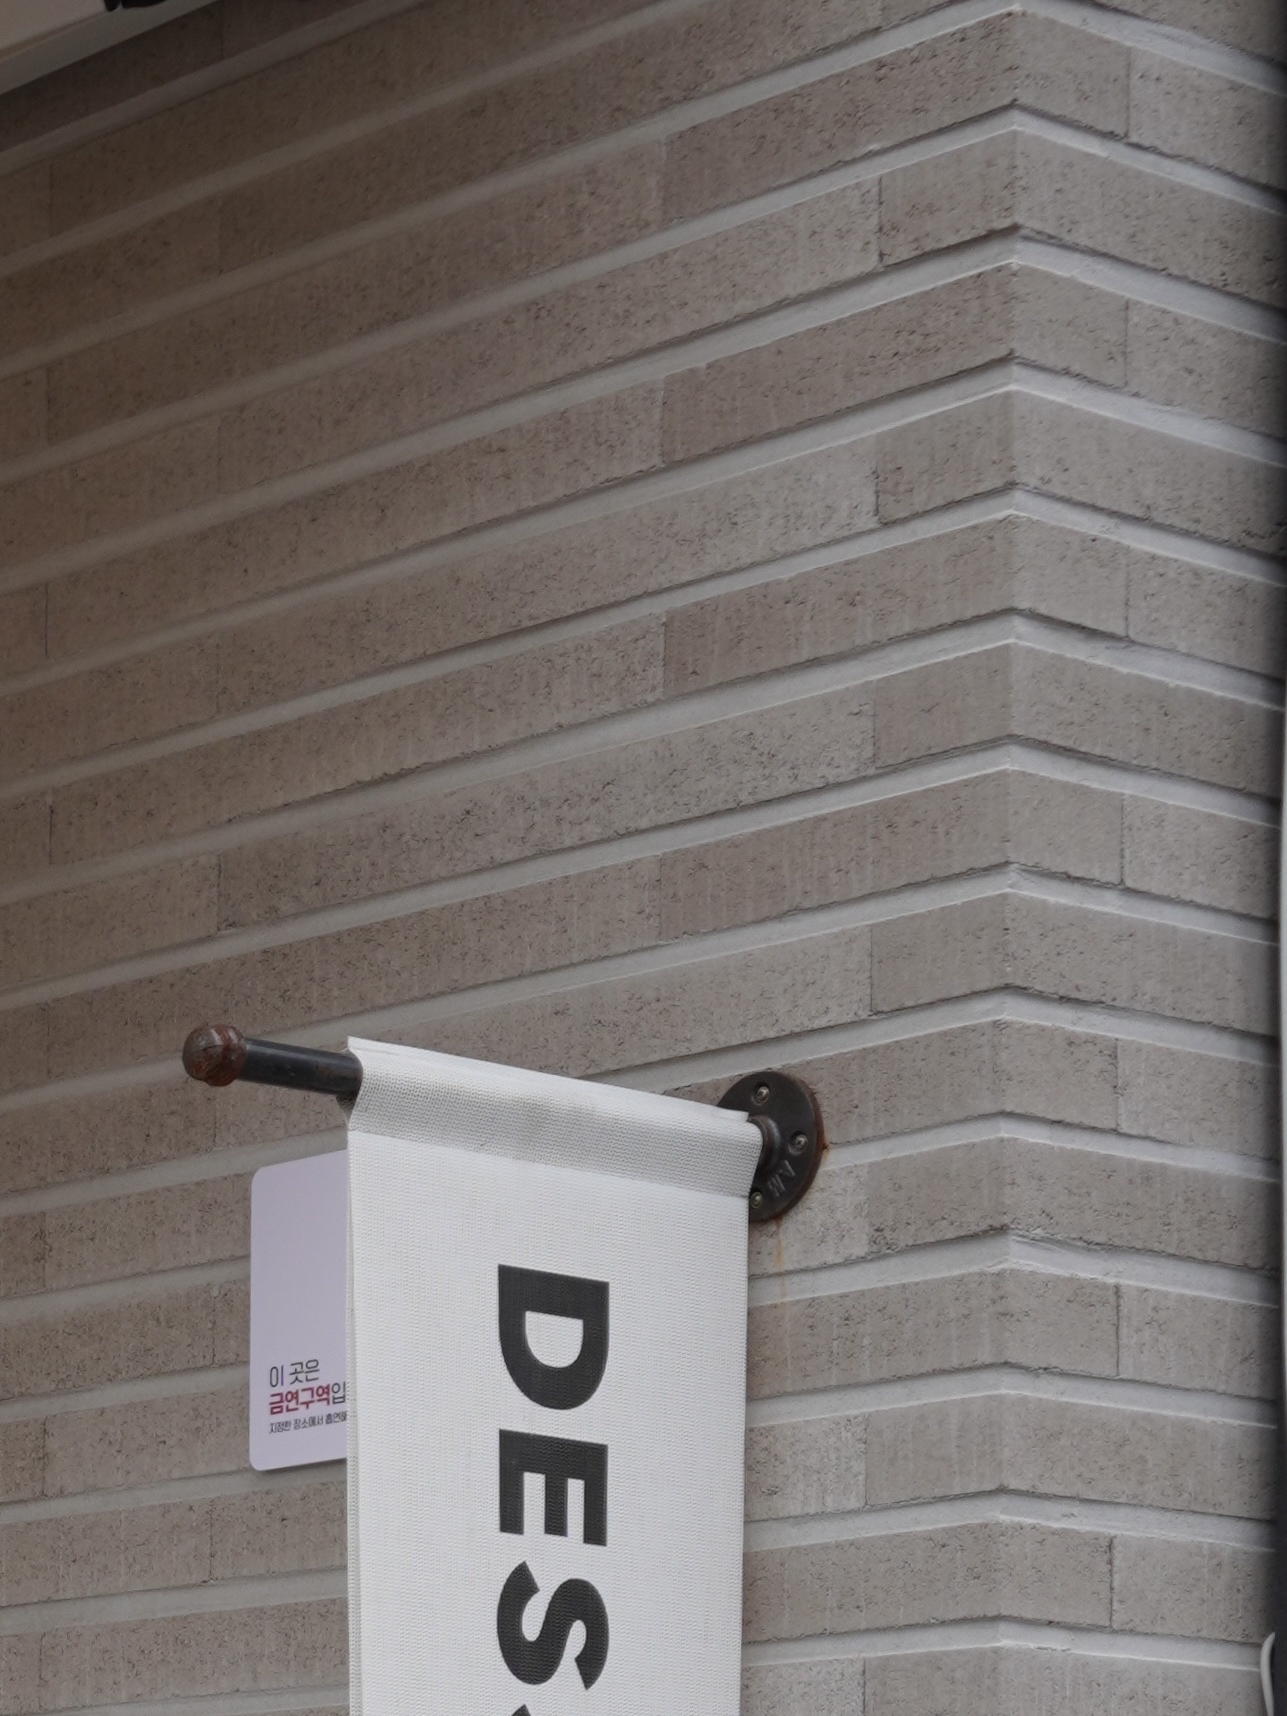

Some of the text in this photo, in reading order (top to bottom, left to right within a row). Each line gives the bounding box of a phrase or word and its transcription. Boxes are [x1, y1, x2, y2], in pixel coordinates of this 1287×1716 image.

[270, 1359, 320, 1388] 이 곳은
[293, 1414, 324, 1431] 장소에서
